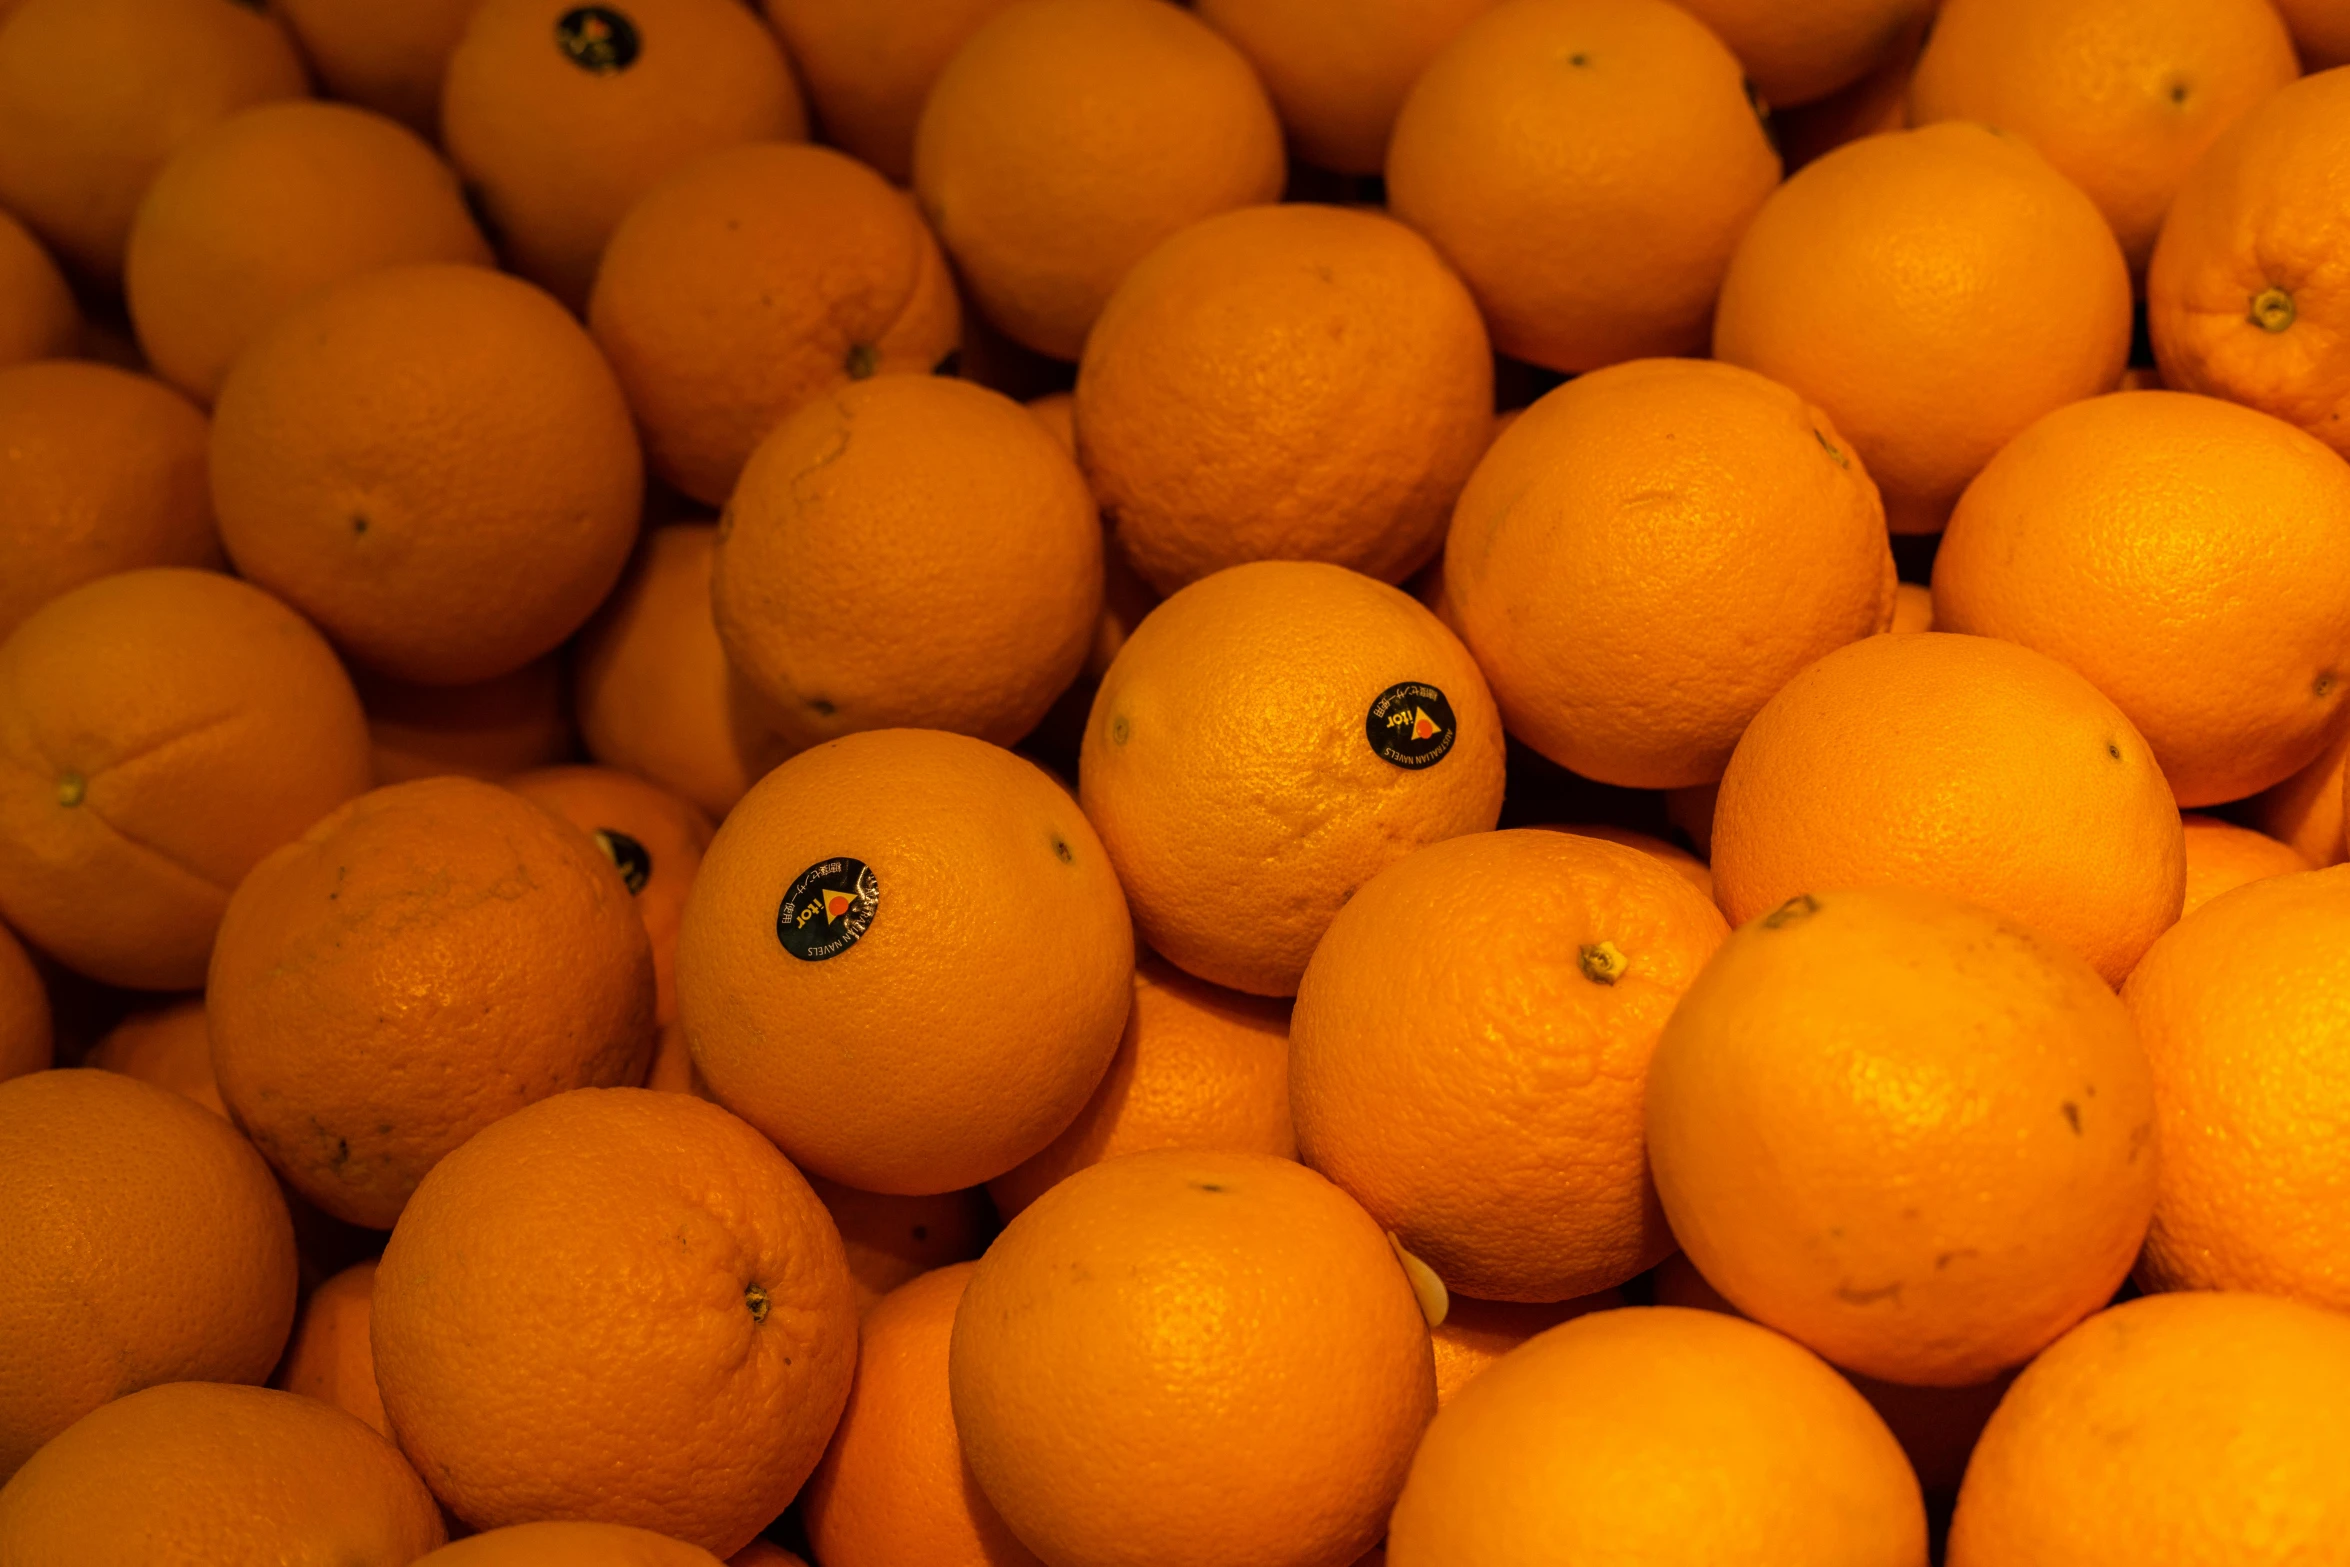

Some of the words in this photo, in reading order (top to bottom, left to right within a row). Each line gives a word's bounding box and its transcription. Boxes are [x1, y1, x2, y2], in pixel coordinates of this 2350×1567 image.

[1416, 728, 1454, 764] AUSTRALIAN
[1384, 747, 1414, 765] NAVELS
[807, 941, 843, 956] NAVELS
